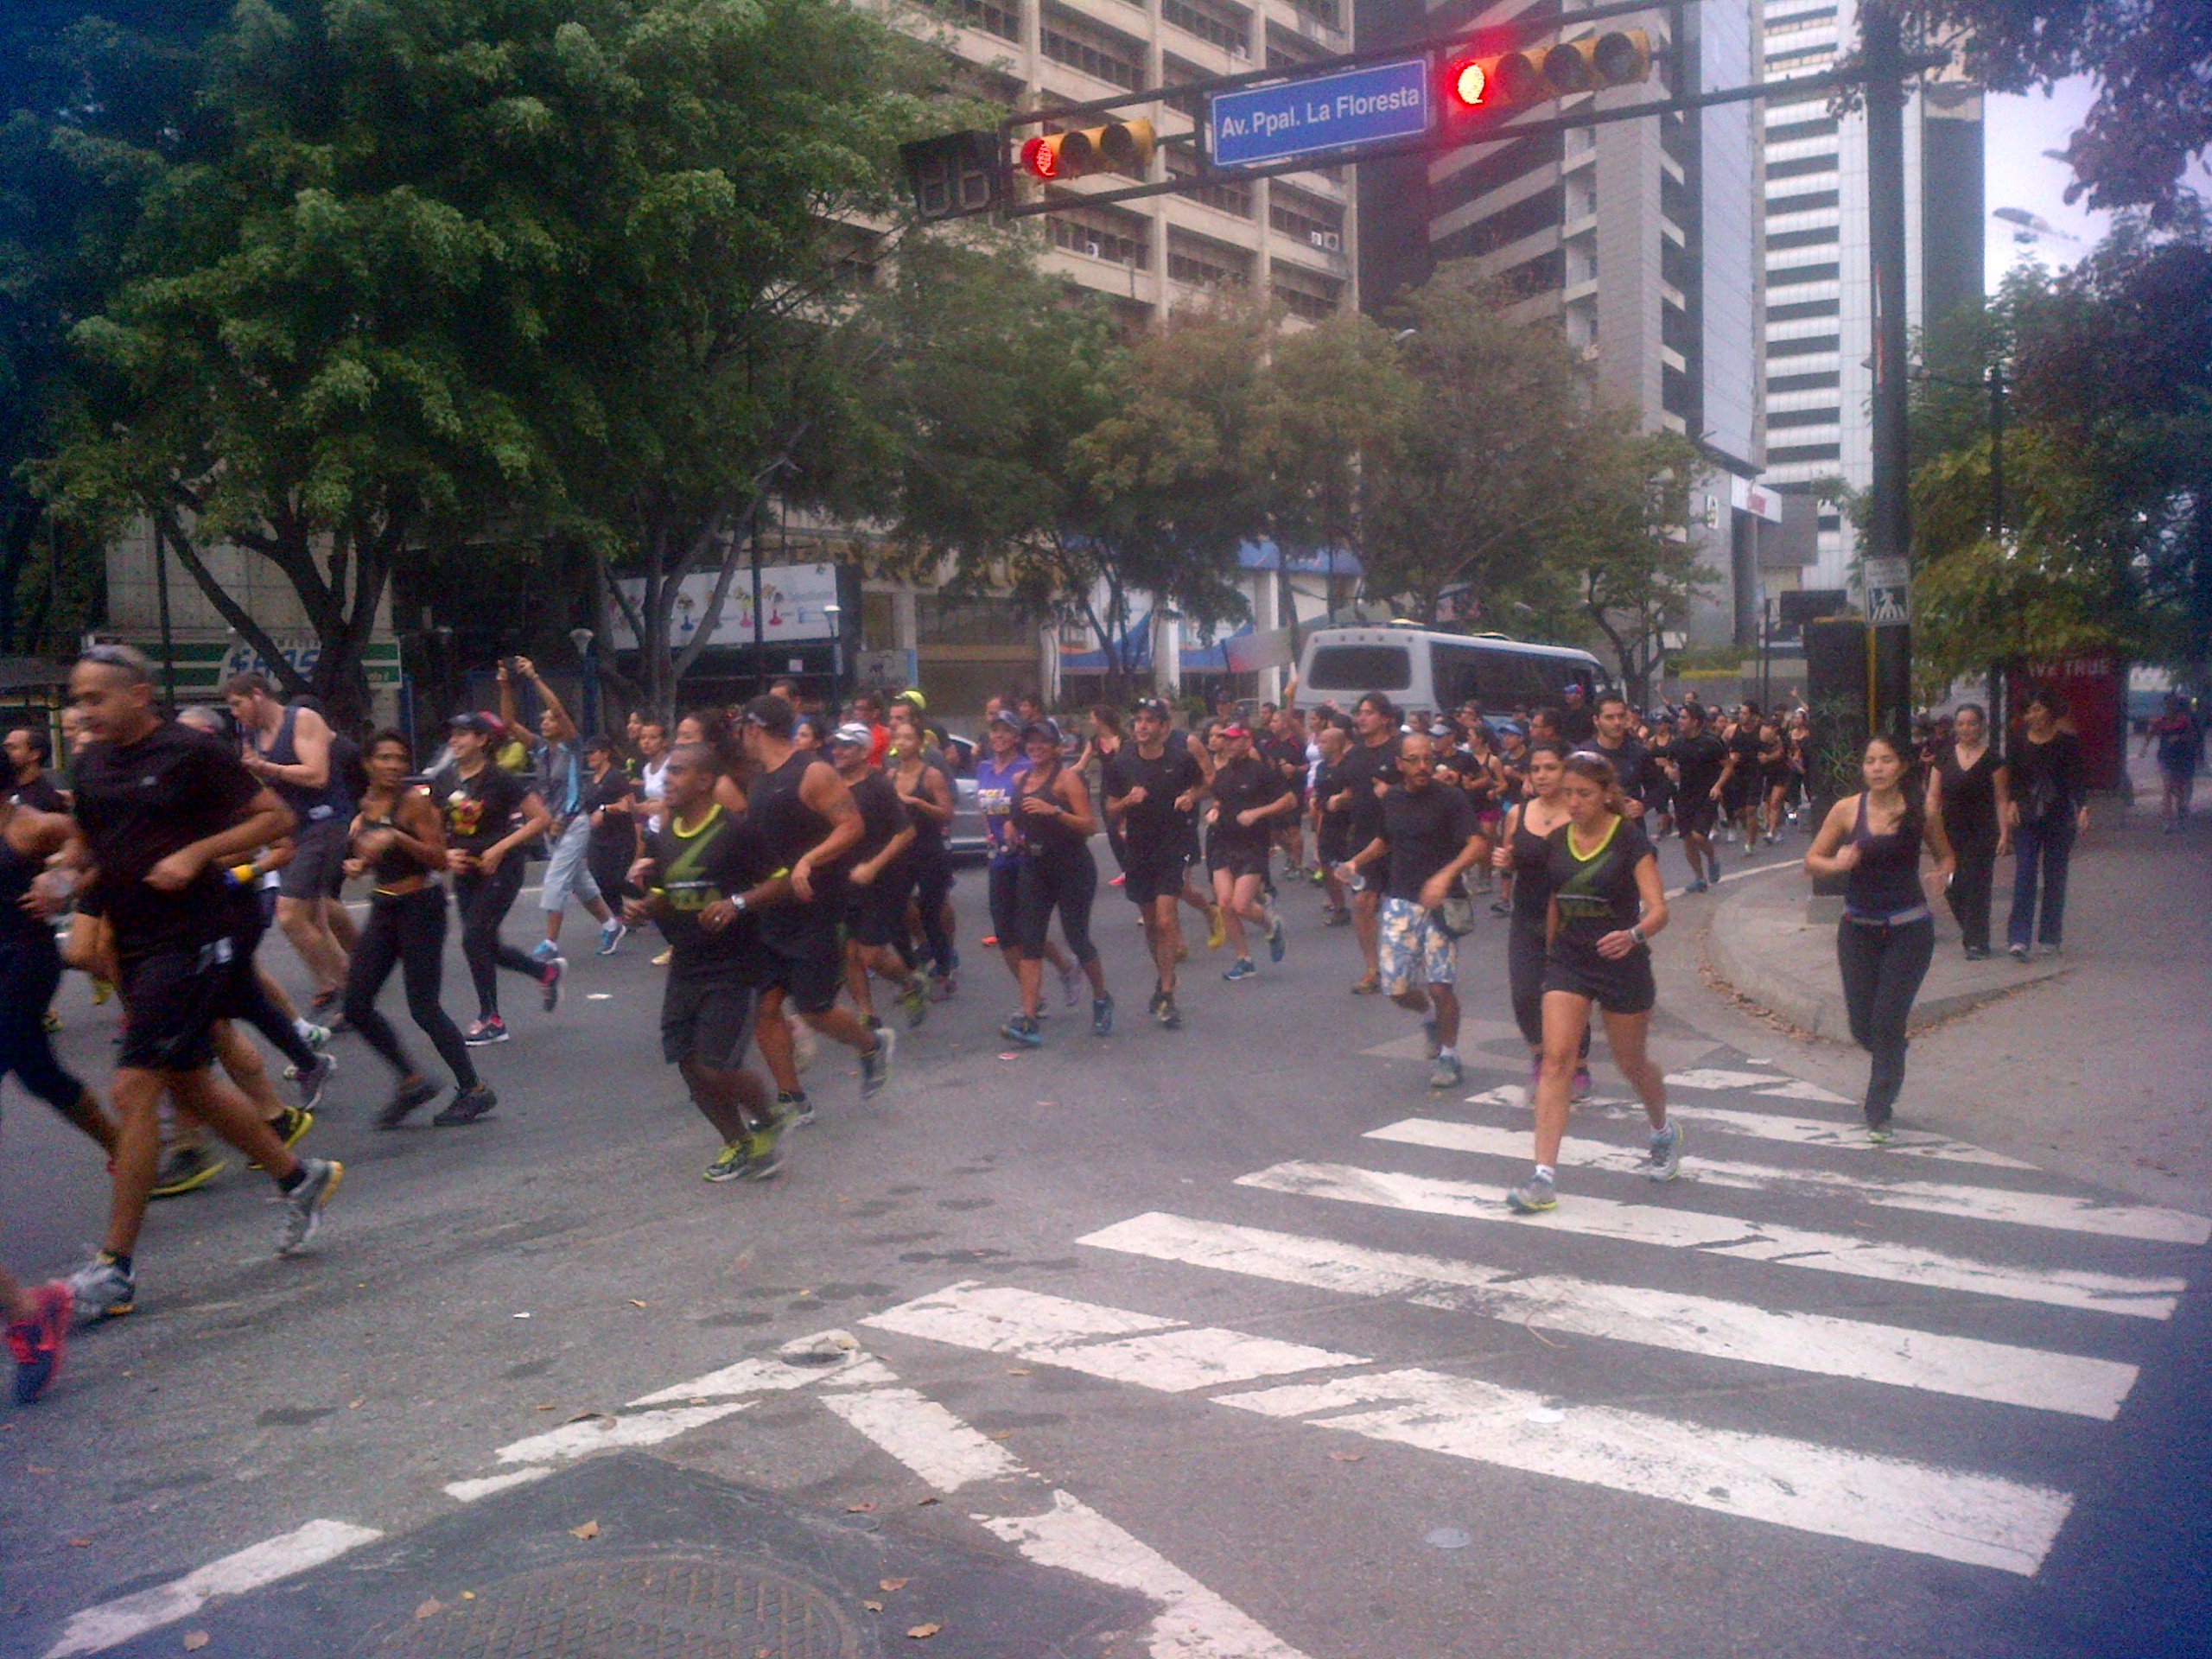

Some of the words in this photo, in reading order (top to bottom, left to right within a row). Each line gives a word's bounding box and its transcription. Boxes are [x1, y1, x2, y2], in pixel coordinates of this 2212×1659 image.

[1221, 116, 1249, 139] Av.
[1253, 106, 1300, 137] Ppal.
[1306, 102, 1331, 124] La
[1336, 86, 1420, 119] Floresta
